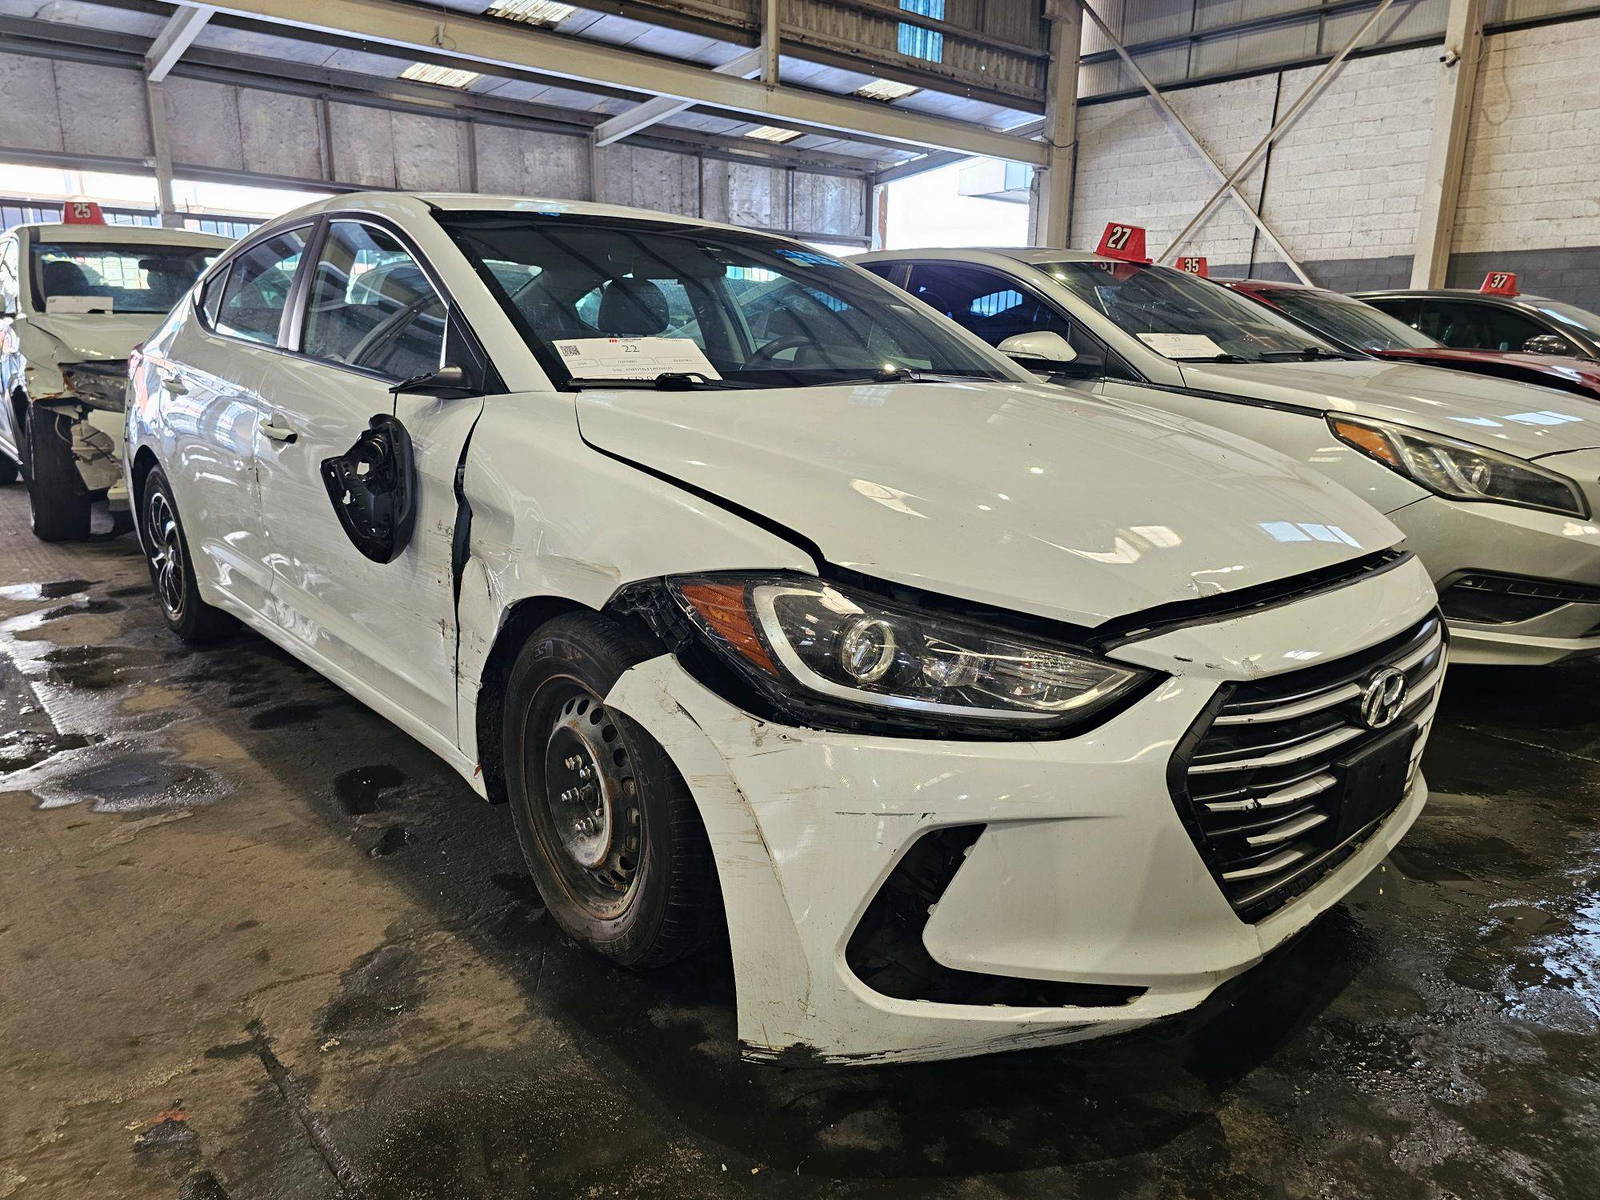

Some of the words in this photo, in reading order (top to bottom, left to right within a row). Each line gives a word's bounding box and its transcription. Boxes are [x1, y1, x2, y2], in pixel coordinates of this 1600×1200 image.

[73, 203, 91, 218] 25
[1106, 226, 1132, 250] 27
[1184, 258, 1200, 273] 35
[1490, 274, 1508, 288] 37
[622, 344, 640, 353] 22
